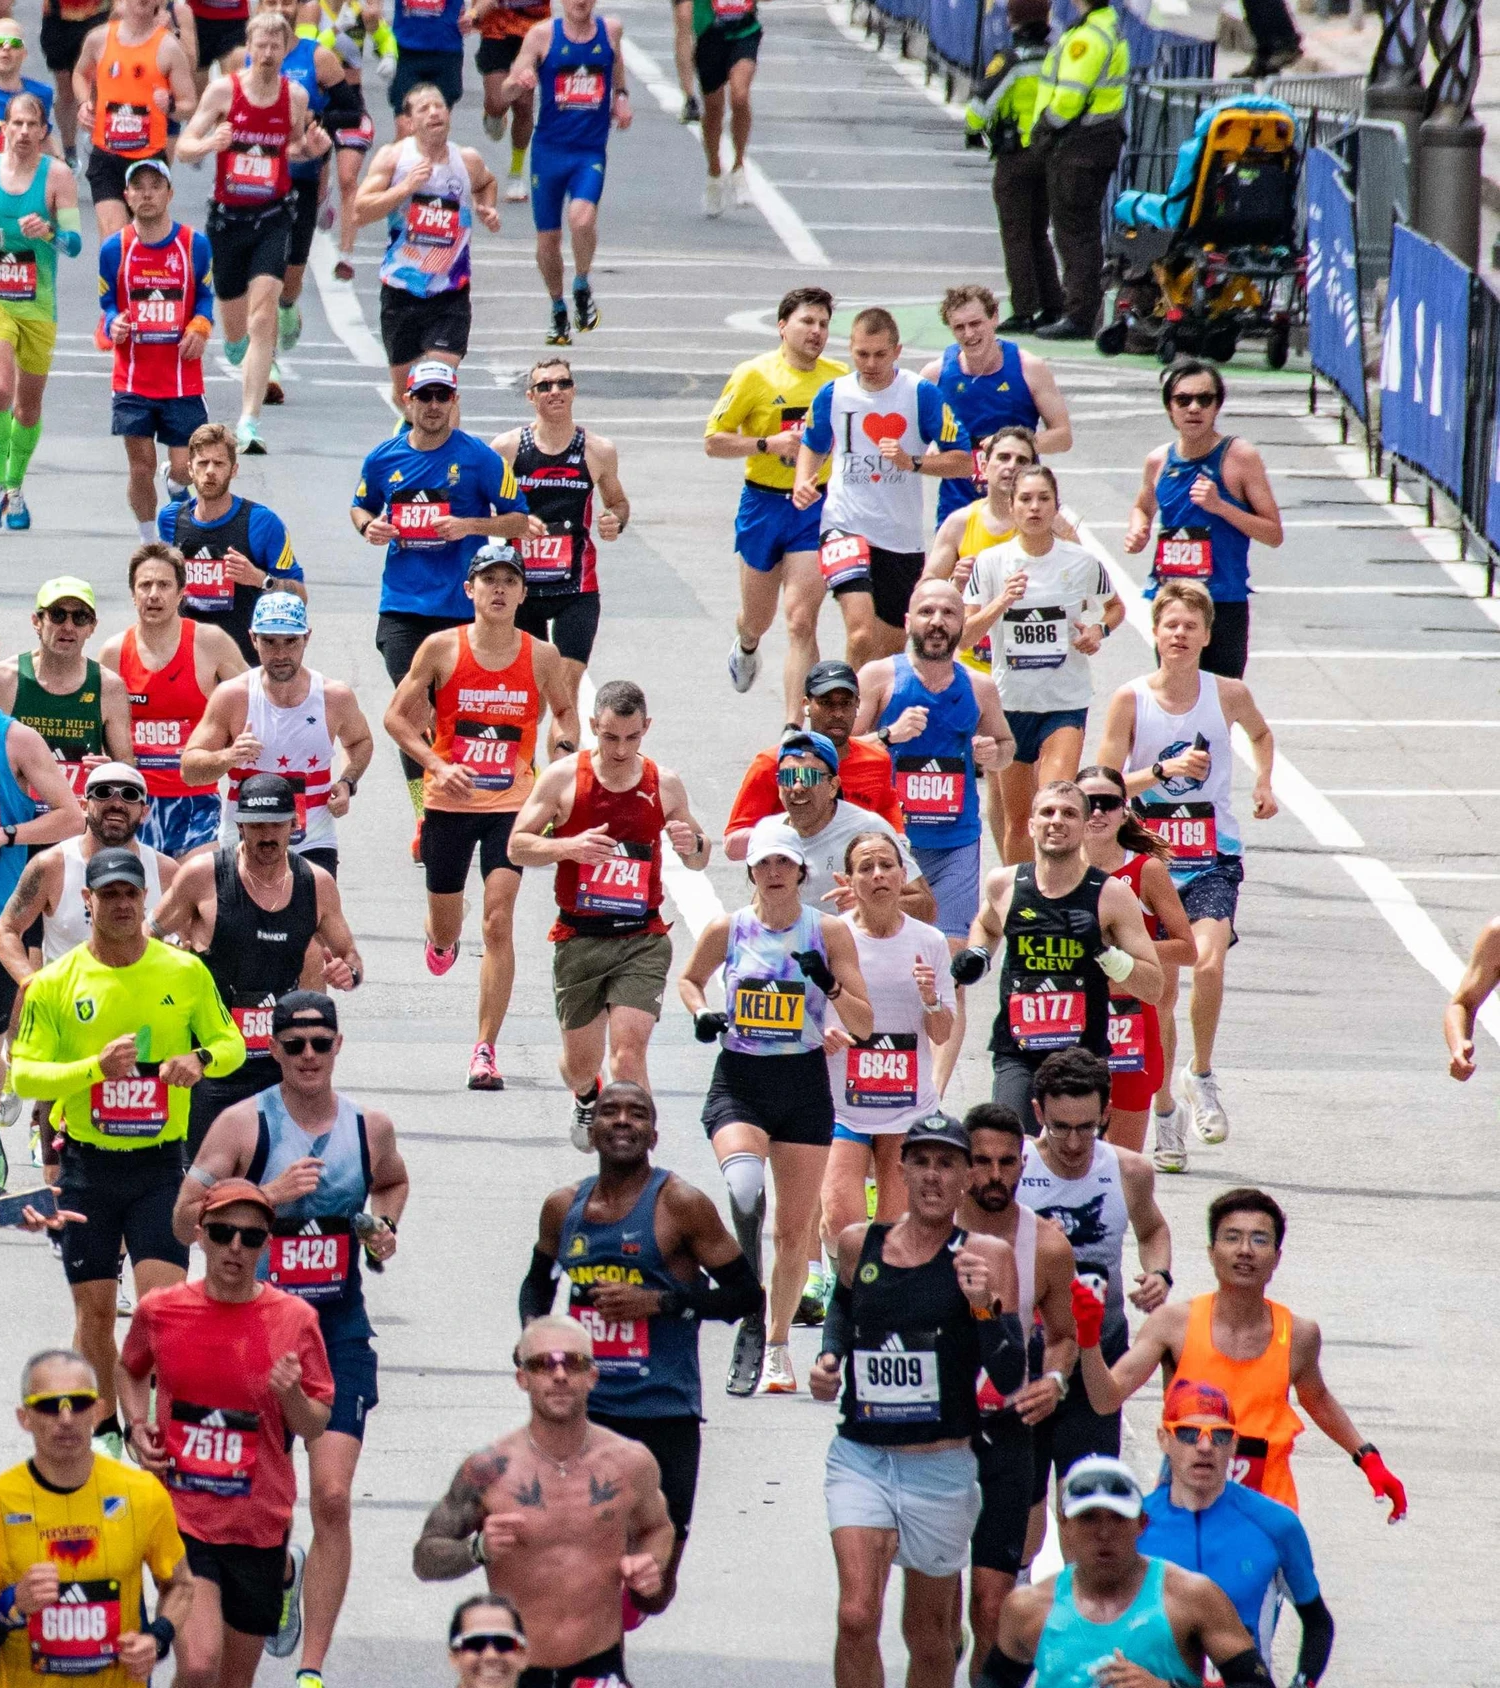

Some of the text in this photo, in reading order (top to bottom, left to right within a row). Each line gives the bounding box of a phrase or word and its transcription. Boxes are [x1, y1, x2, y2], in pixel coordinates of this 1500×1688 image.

[415, 206, 454, 229] 7542
[137, 302, 175, 323] 2416
[840, 410, 858, 454] I
[840, 454, 902, 474] JESU
[514, 476, 589, 490] playmakers
[843, 475, 871, 485] ESUS
[521, 538, 563, 560] 6127
[184, 561, 224, 586] 6854
[1013, 624, 1057, 645] 9686
[458, 688, 528, 704] IRONMAN
[20, 716, 95, 730] FOREST HILLS
[462, 739, 509, 764] 7818
[906, 774, 954, 801] 6604
[1158, 820, 1206, 847] 4189
[590, 859, 641, 888] 7734
[1017, 935, 1085, 958] K-LIB
[1024, 955, 1074, 971] CREW
[739, 992, 801, 1022] KELLY
[1021, 994, 1073, 1023] 6177
[858, 1051, 908, 1080] 6843
[102, 1077, 157, 1109] 5922
[1021, 1176, 1051, 1188] FCTC
[571, 1264, 644, 1286] ANGOLA
[866, 1356, 923, 1388] 9809
[40, 1607, 107, 1643] 6006
